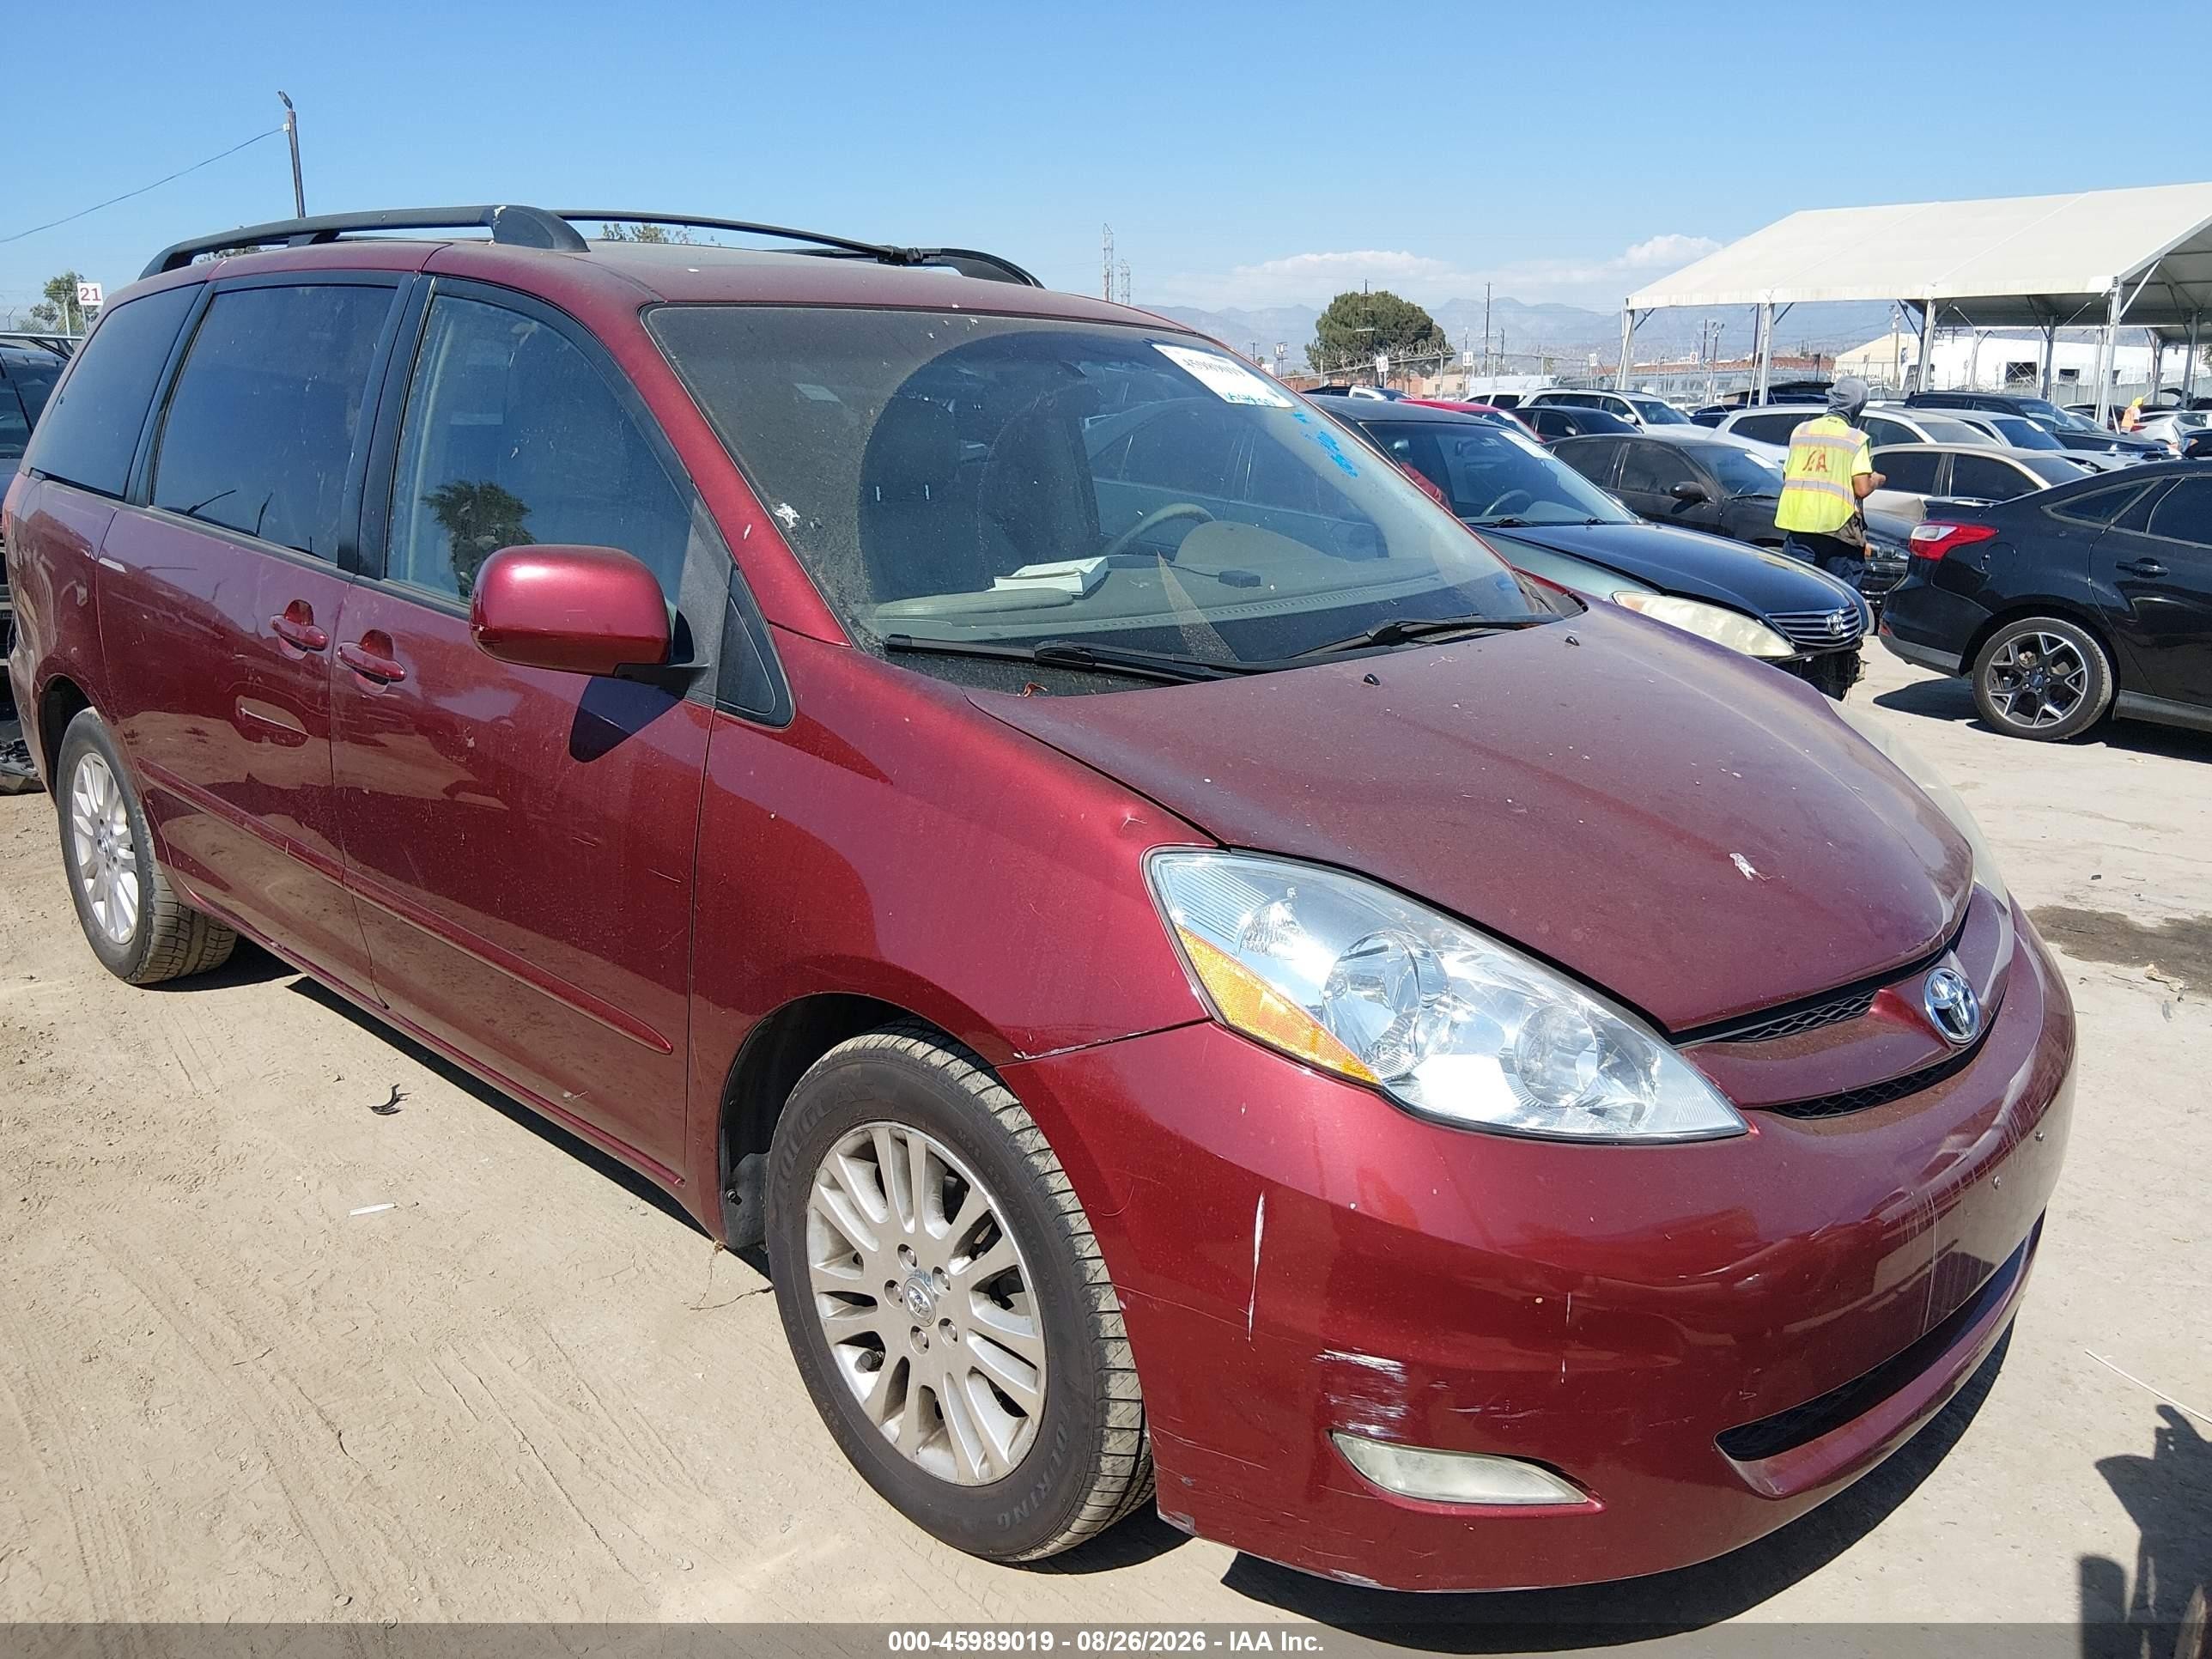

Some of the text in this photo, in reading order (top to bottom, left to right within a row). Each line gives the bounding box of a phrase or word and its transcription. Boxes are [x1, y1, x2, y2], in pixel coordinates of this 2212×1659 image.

[80, 287, 101, 301] 21
[1692, 353, 1696, 362] 9
[1377, 360, 1388, 369] 12
[994, 1397, 1072, 1533] TOURING
